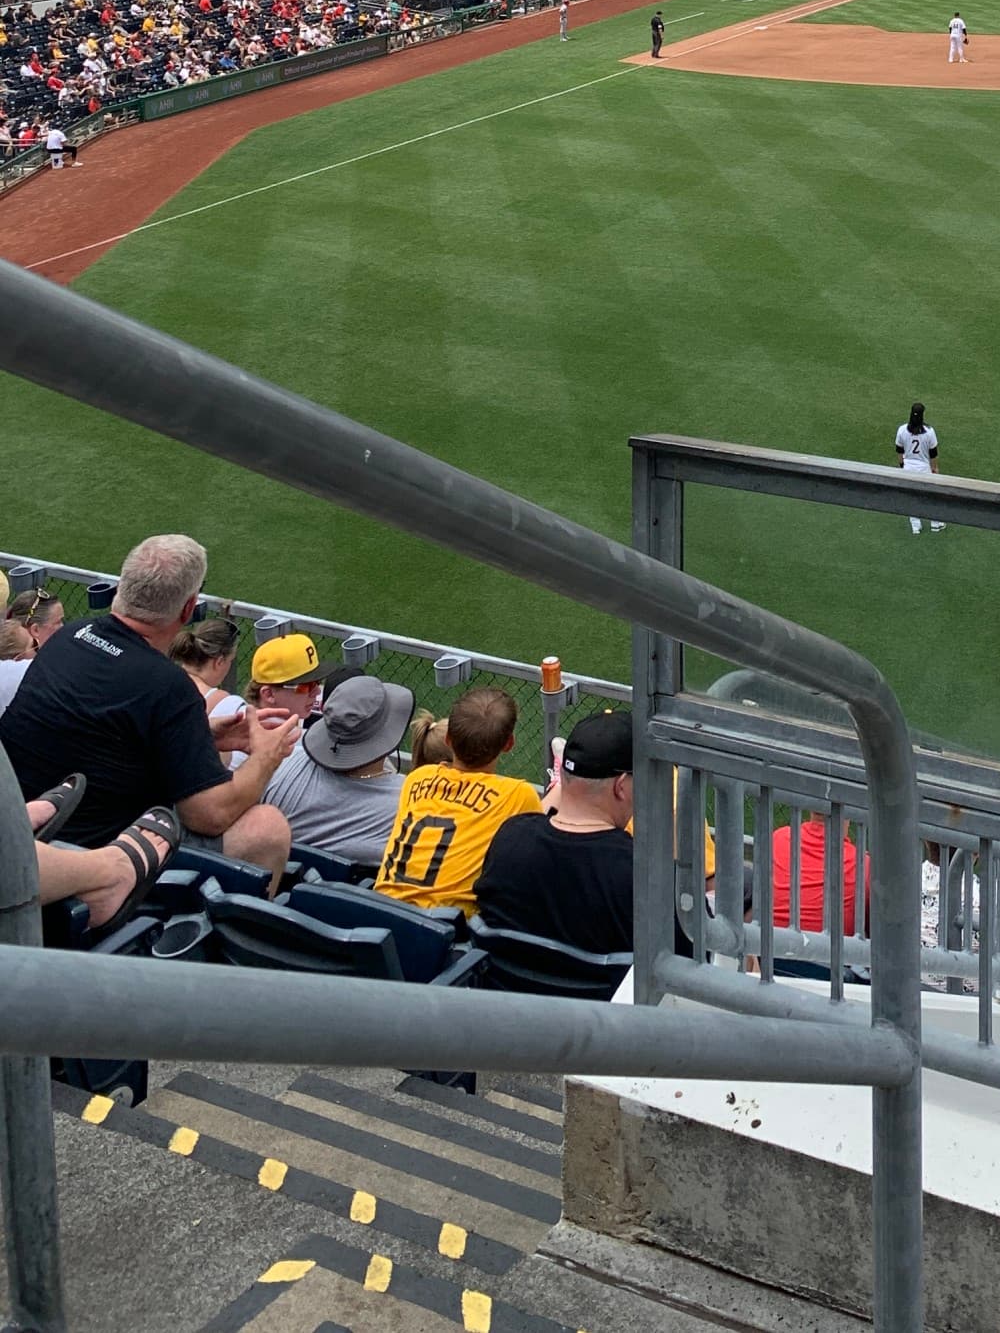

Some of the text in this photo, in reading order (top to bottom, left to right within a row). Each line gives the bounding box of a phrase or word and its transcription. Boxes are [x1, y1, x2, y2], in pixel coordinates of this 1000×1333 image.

[911, 439, 920, 454] 2
[306, 646, 314, 664] P
[384, 810, 457, 887] 10
